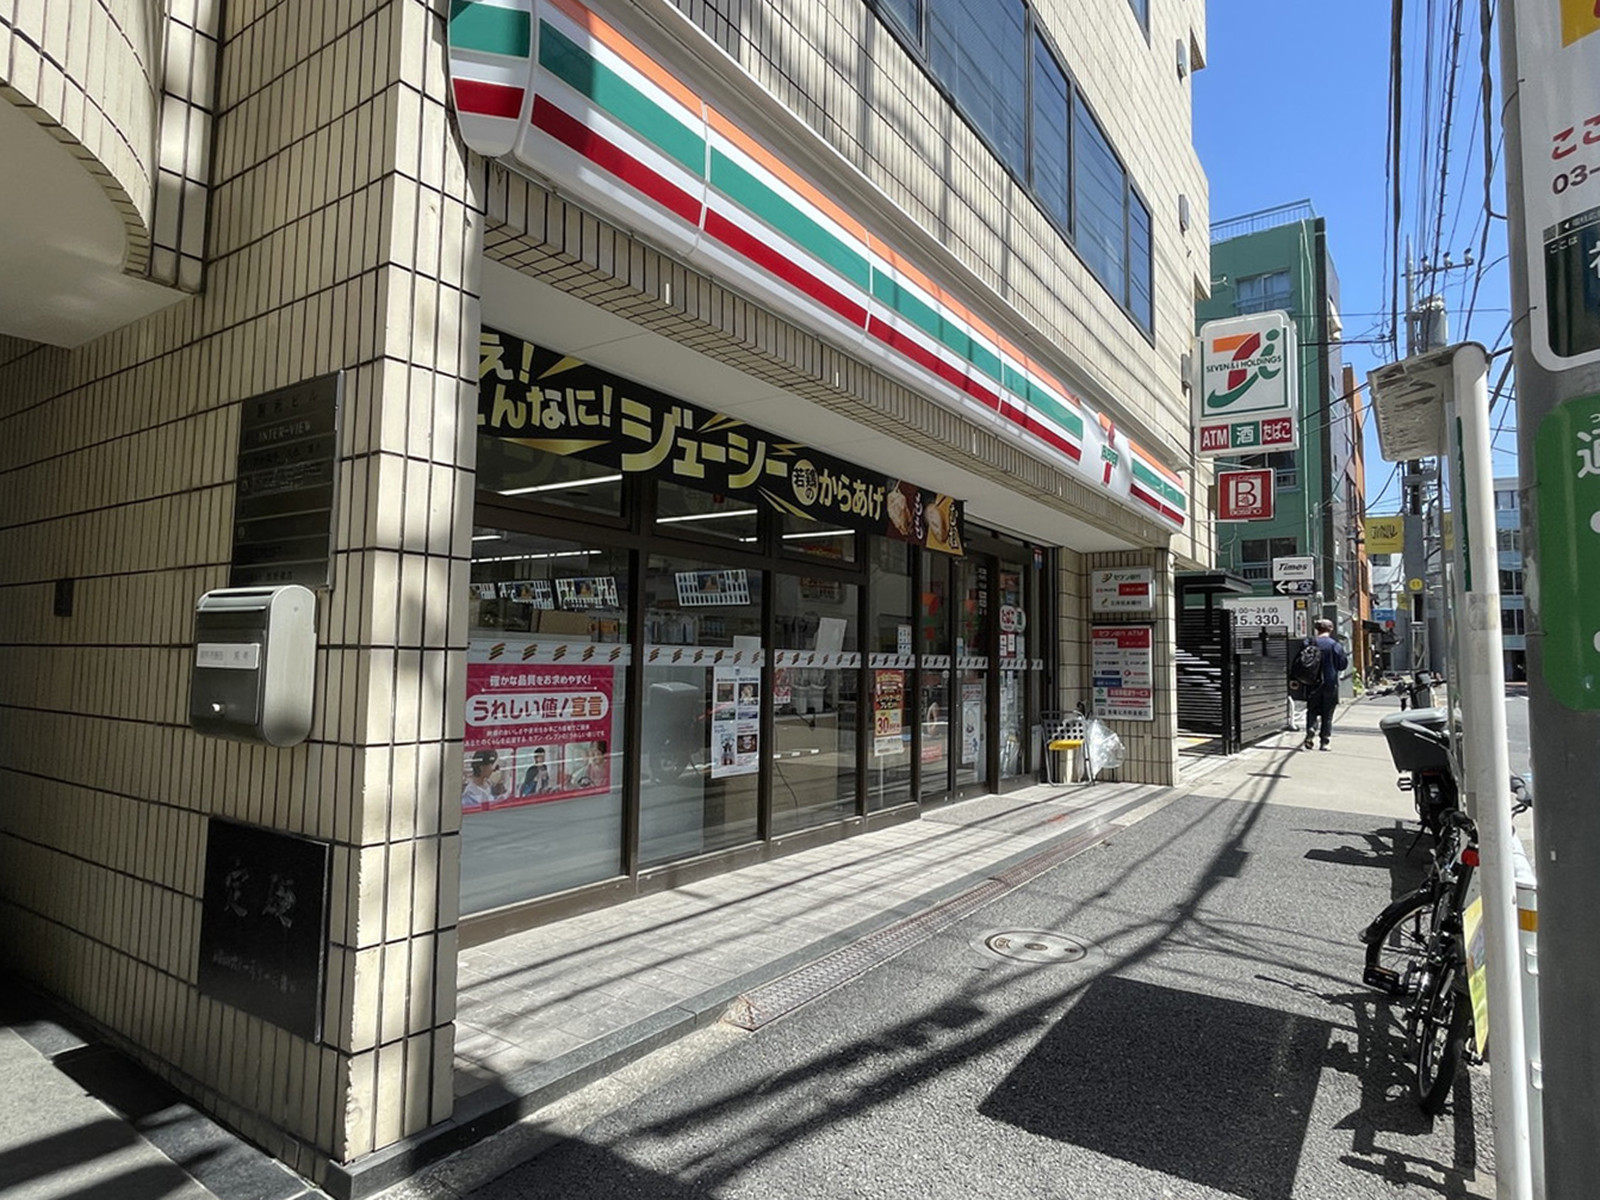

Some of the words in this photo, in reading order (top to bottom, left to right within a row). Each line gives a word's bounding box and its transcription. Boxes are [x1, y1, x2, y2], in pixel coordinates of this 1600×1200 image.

[1240, 355, 1281, 368] HOLDINGS
[478, 383, 613, 430] んなに!
[621, 397, 788, 489] ジューシー
[1202, 429, 1227, 448] ATM
[1236, 425, 1255, 445] 酒
[1262, 421, 1291, 441] たばこ
[819, 468, 886, 521] からあげ
[1278, 563, 1308, 571] Times
[473, 696, 603, 722] うれしい値!宣言
